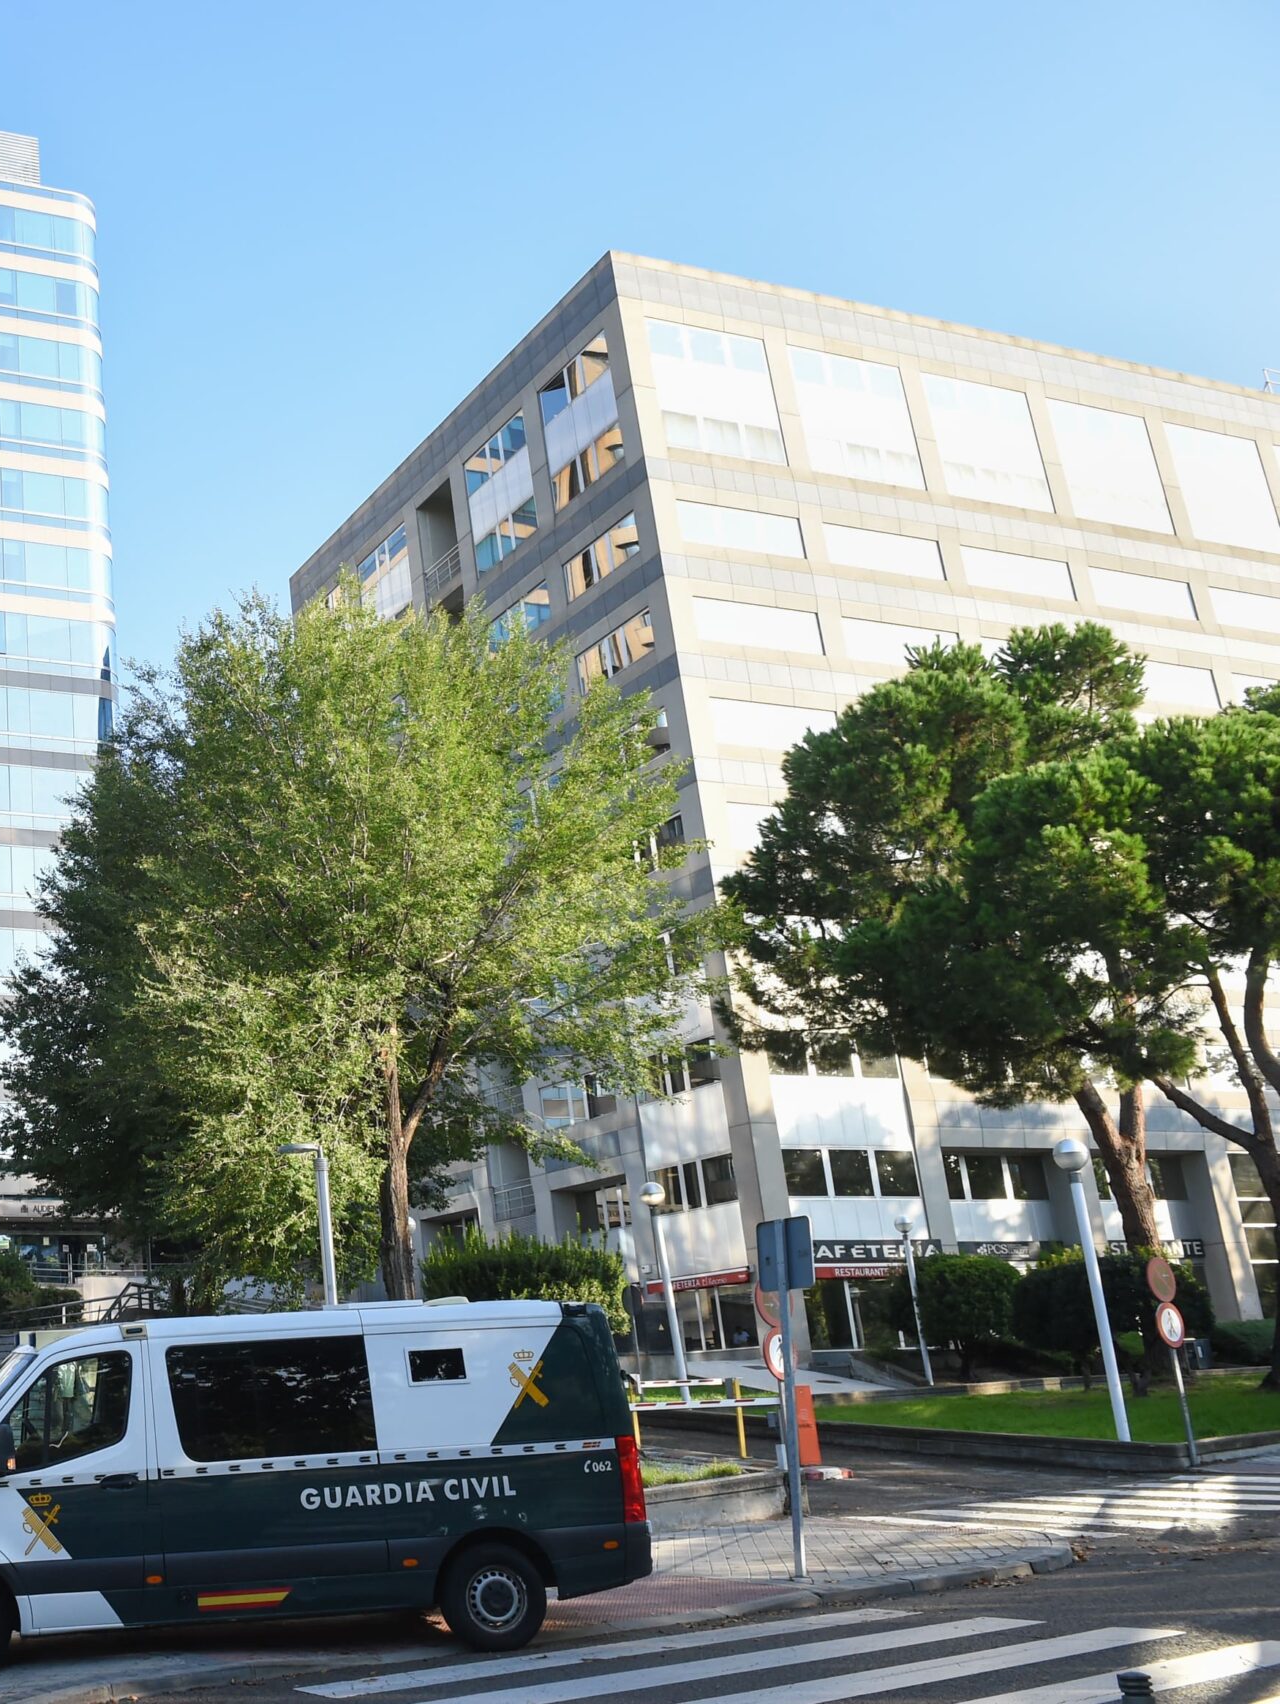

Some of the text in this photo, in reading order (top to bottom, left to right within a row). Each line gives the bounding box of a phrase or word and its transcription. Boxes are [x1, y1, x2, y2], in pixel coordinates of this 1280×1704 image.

[987, 1243, 1008, 1255] PCS
[592, 1460, 612, 1473] 062
[300, 1475, 517, 1510] GUARDIA CIVIL
